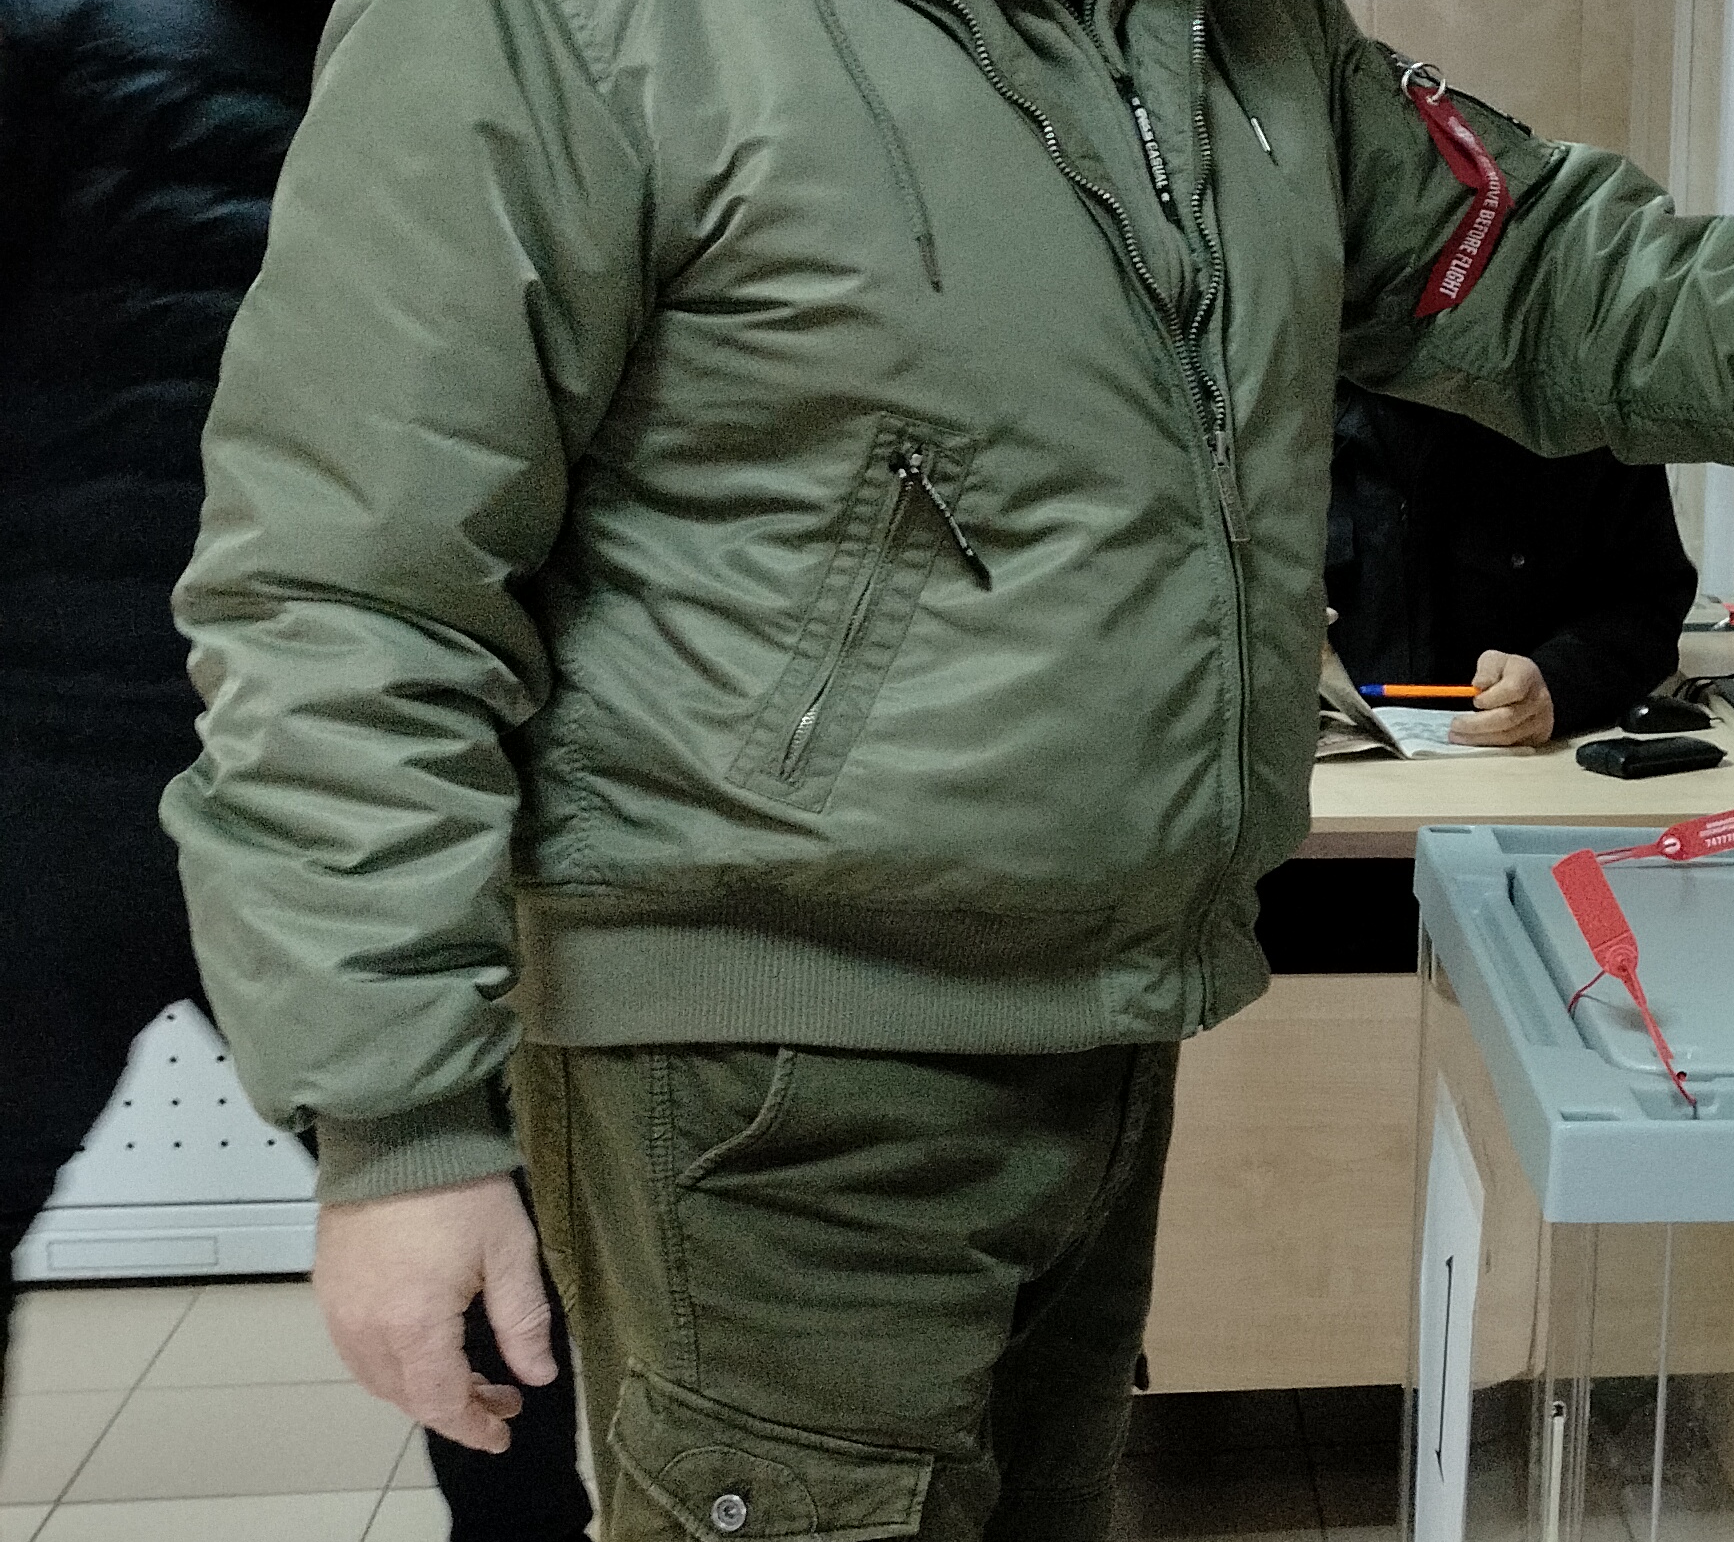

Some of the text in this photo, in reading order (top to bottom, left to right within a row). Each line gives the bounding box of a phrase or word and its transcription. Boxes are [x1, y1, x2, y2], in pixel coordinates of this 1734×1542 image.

[1145, 142, 1168, 189] CASUAL
[1459, 208, 1496, 256] BEFORE
[1439, 253, 1473, 299] FLIGHT
